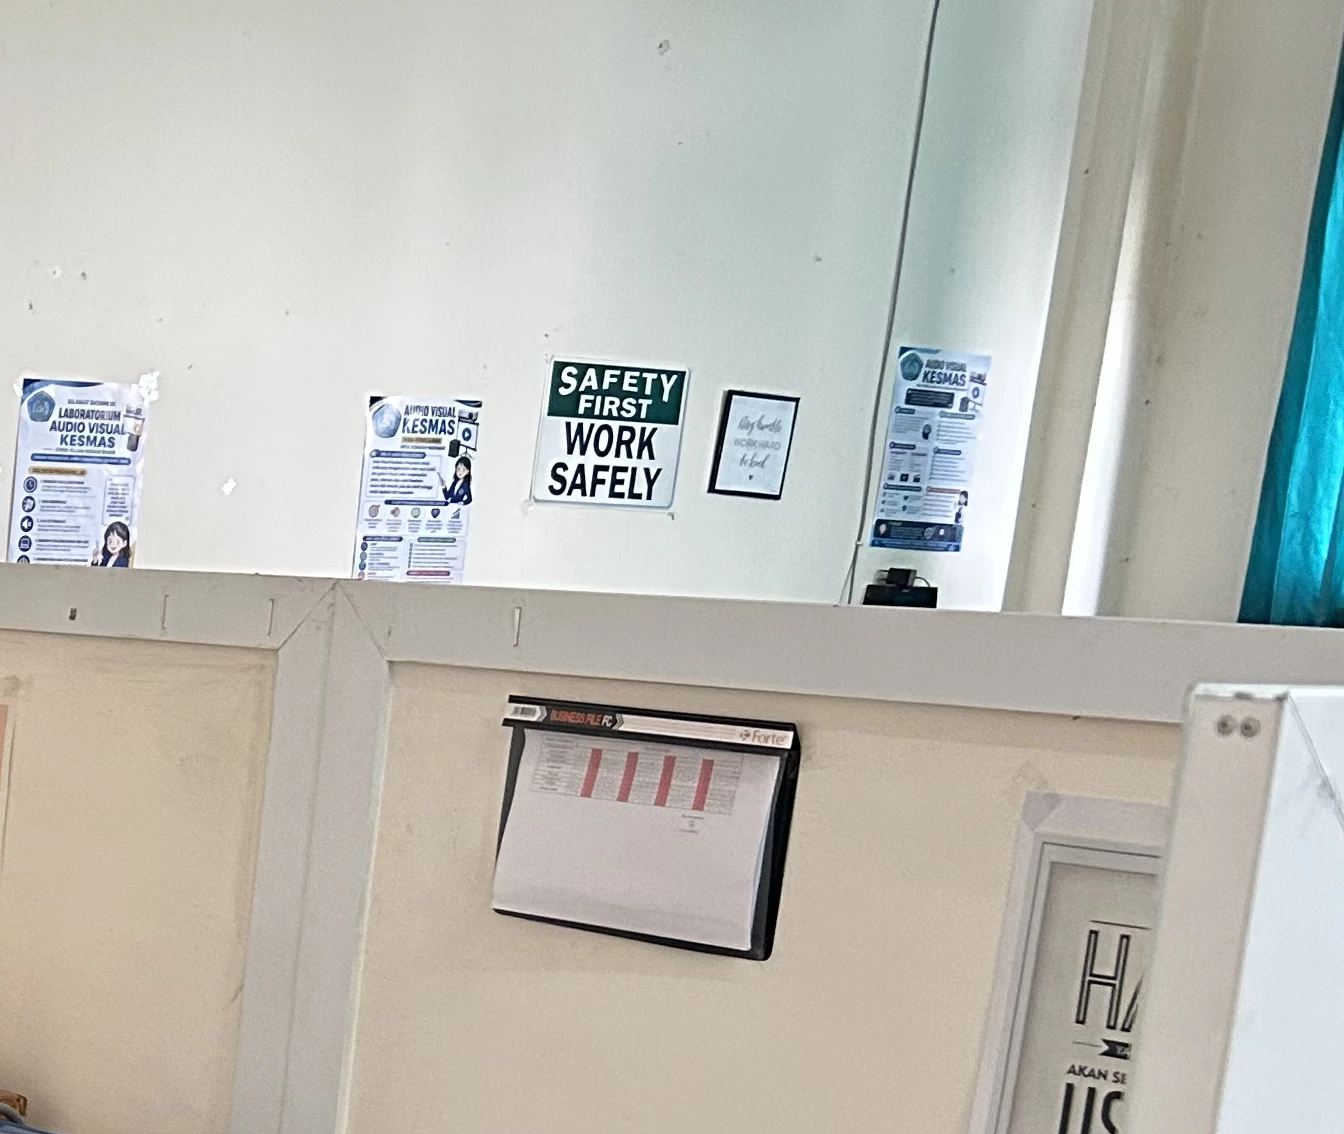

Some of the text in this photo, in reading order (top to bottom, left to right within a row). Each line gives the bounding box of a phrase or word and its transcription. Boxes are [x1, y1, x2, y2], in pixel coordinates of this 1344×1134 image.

[558, 366, 678, 402] SAFETY
[922, 370, 966, 386] KESMAS
[58, 408, 121, 421] LABORATORIUM
[430, 405, 456, 418] VISUAL
[578, 394, 652, 419] FIRST
[49, 421, 126, 435] AUDIO VISUAL
[401, 418, 456, 435] KESMAS
[60, 434, 115, 448] KESMAS
[565, 421, 658, 460] WORK
[548, 462, 662, 500] SAFELY
[752, 730, 784, 745] Forte
[1067, 1064, 1108, 1081] AKAN
